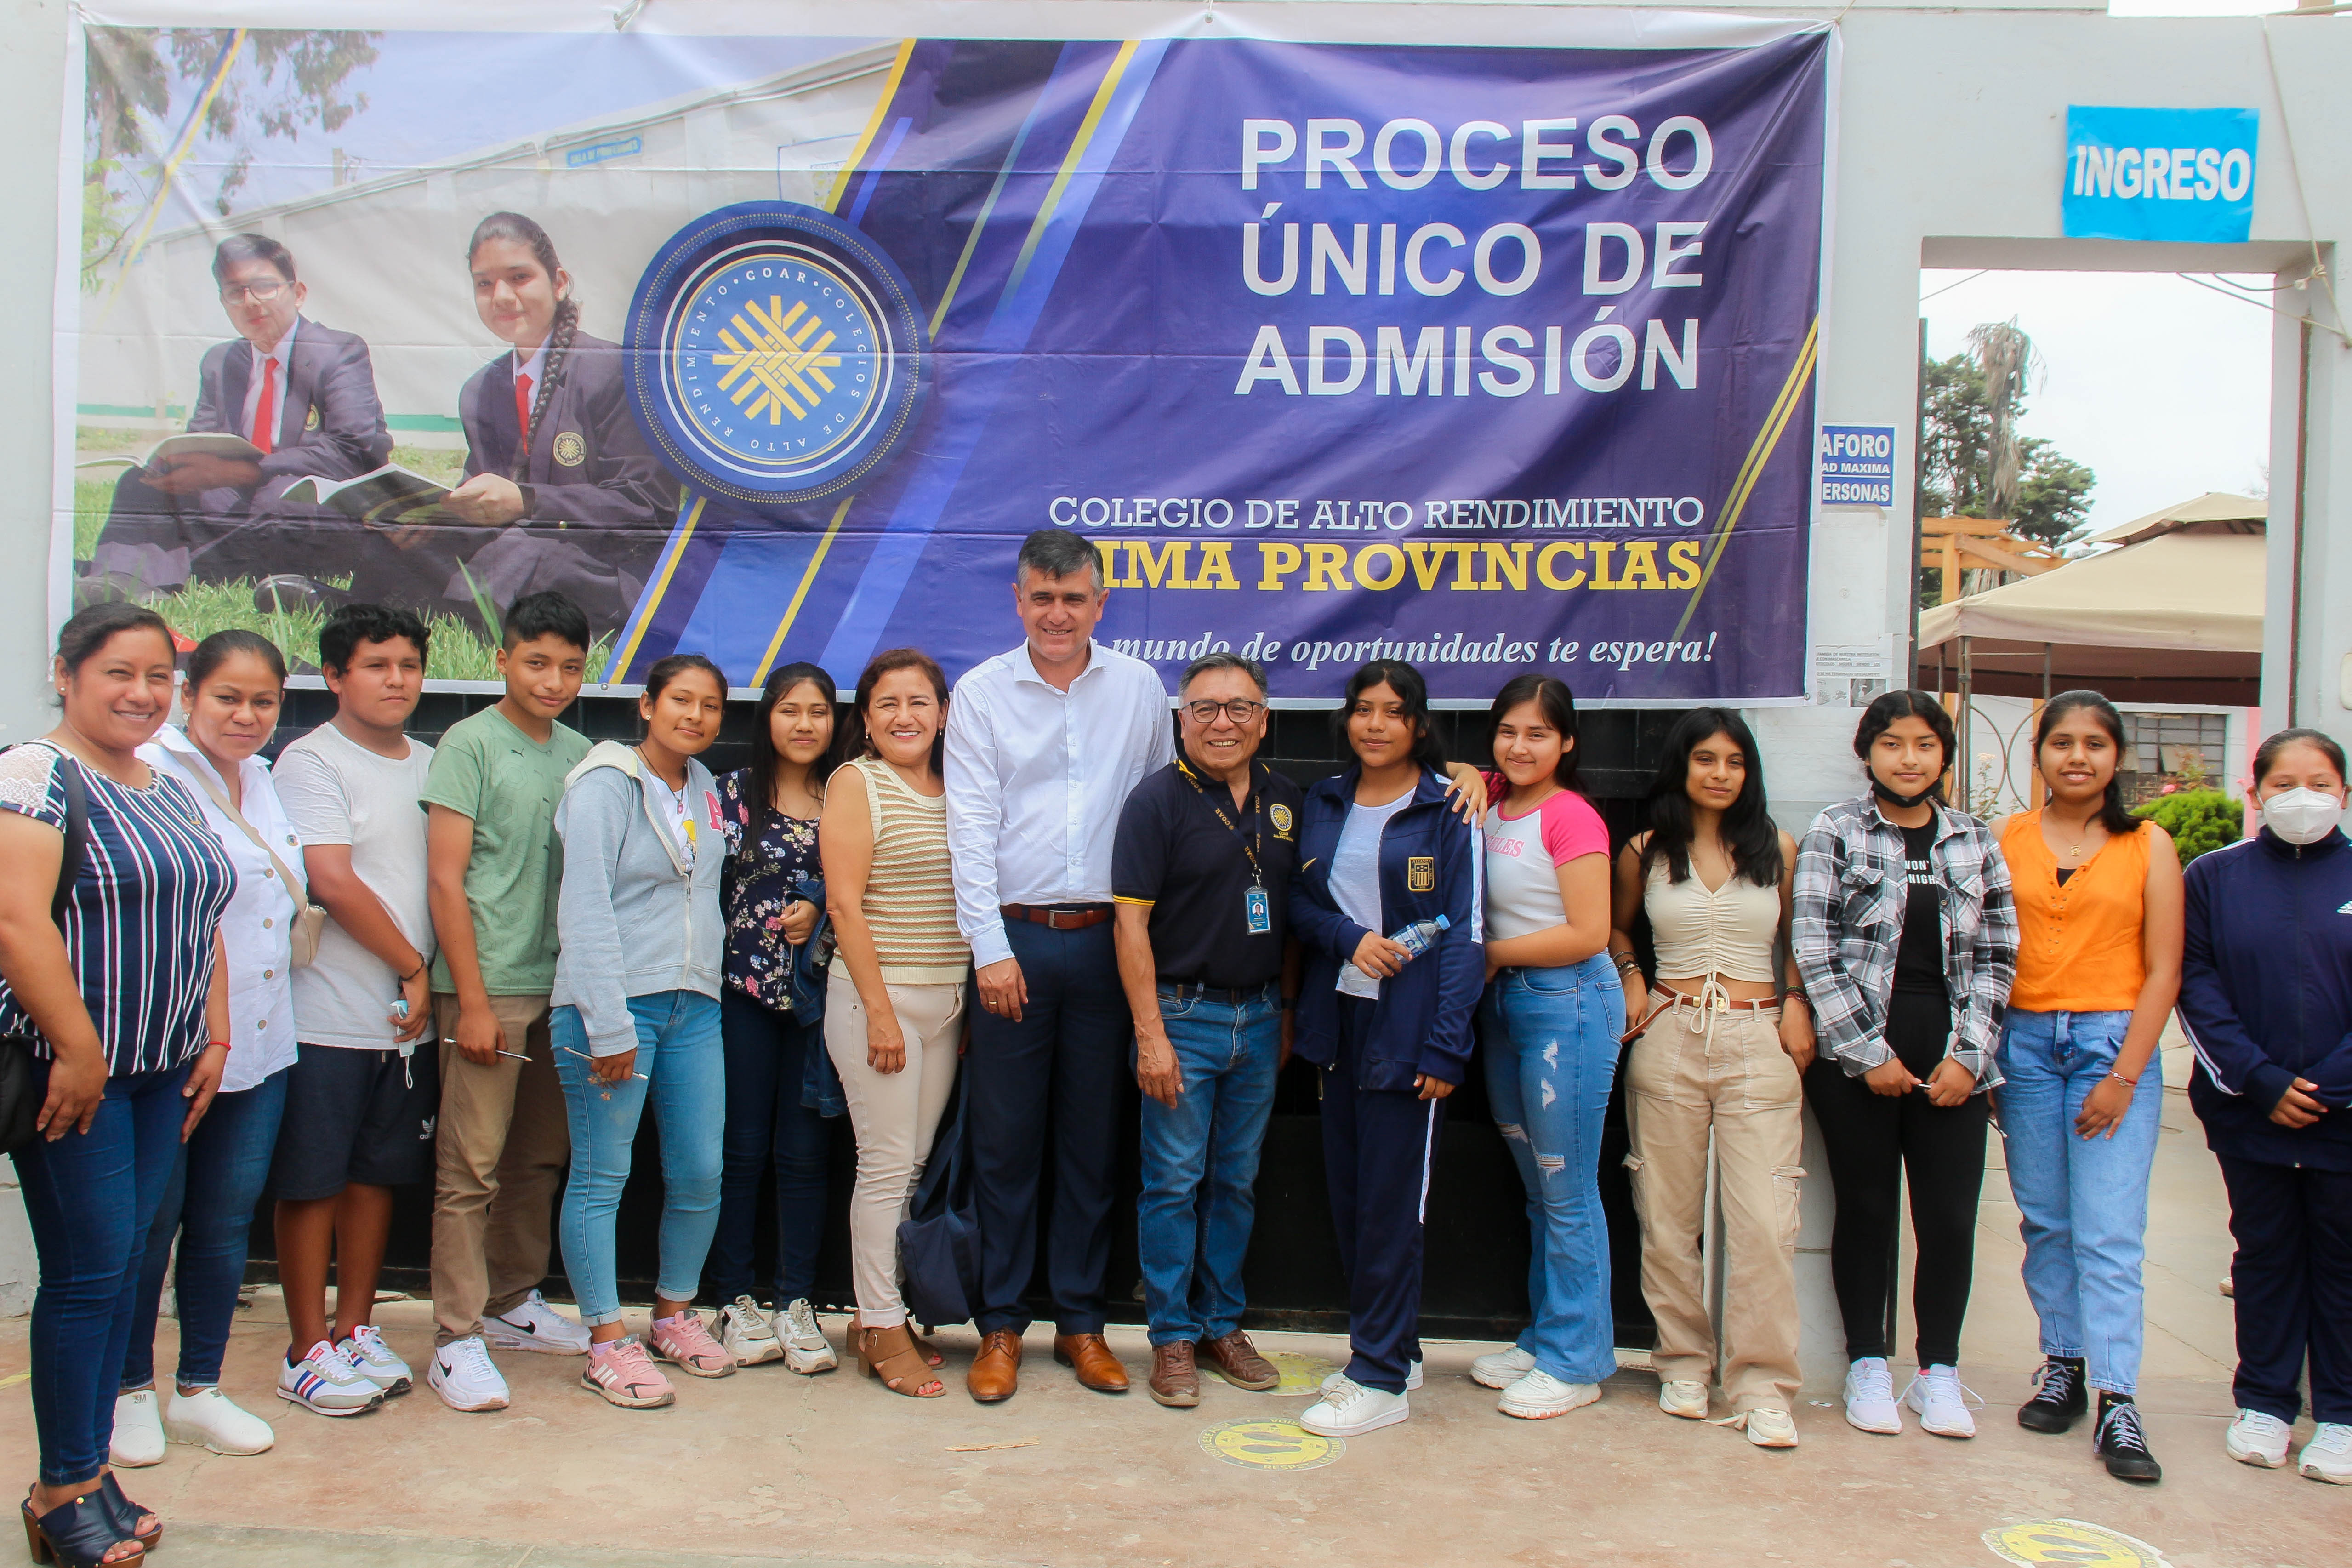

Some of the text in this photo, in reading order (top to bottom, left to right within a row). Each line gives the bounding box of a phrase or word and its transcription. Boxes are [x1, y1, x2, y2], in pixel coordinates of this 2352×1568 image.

[1242, 116, 1713, 191] PROCESO
[2073, 145, 2251, 202] INGRESO
[1242, 202, 1709, 297] ÚNICO DE
[688, 267, 866, 452] COAR COLEGIOS DE ALTO RENDIMIENTO
[1234, 306, 1698, 398] ADMISIÓN
[1822, 433, 1890, 458] AFORO
[1841, 463, 1890, 473] MAXIMA
[1049, 496, 1704, 530] COLEGIO DE ALTO RENDIMIENTO
[1822, 483, 1890, 502] ERSONAS
[1093, 540, 1702, 591] IMA PROVINCIAS
[1112, 631, 1717, 671] mundo de oportunidades te espera!
[1215, 808, 1230, 825] COAR
